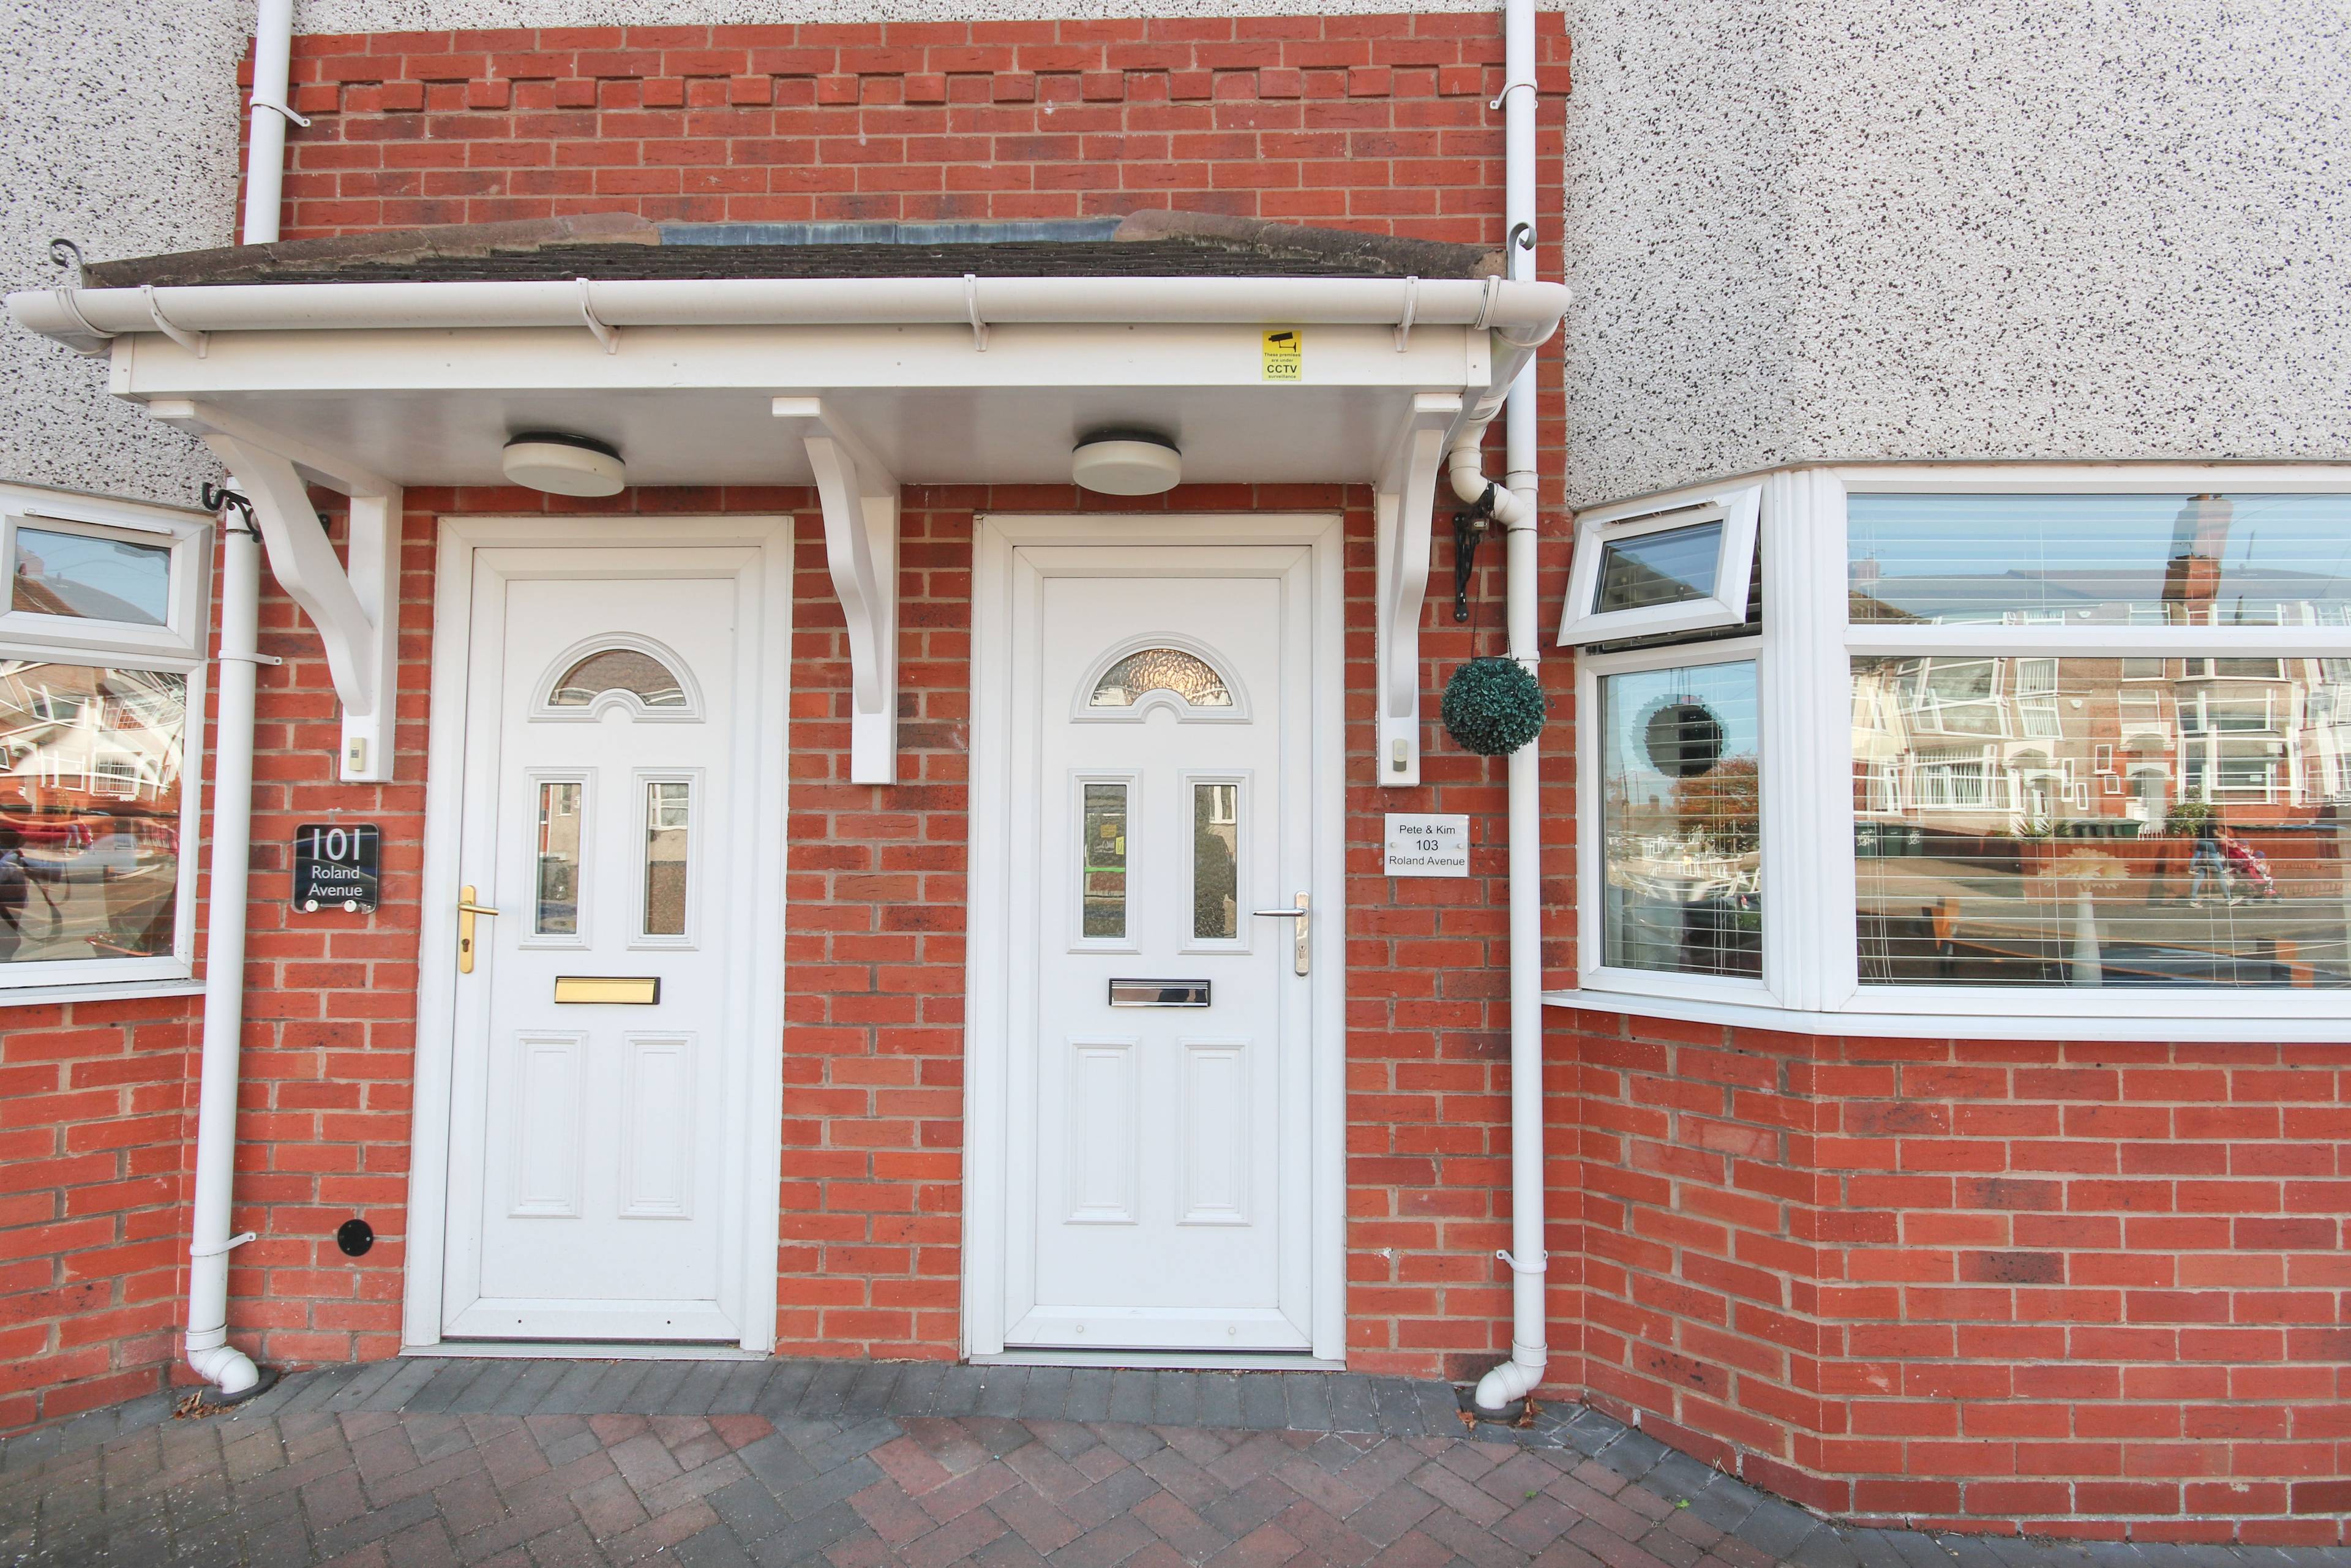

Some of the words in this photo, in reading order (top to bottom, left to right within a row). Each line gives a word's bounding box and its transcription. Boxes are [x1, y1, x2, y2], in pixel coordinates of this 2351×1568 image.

[1267, 364, 1297, 373] CCTV
[1400, 825, 1422, 834] Pete
[1426, 825, 1433, 834] &
[1436, 825, 1455, 834] Kim
[313, 828, 360, 860] 101
[1416, 839, 1439, 851] 103
[1389, 855, 1424, 865] Roland
[1427, 856, 1465, 866] Avenue
[312, 865, 359, 879] Roland
[308, 883, 362, 896] Avenue
